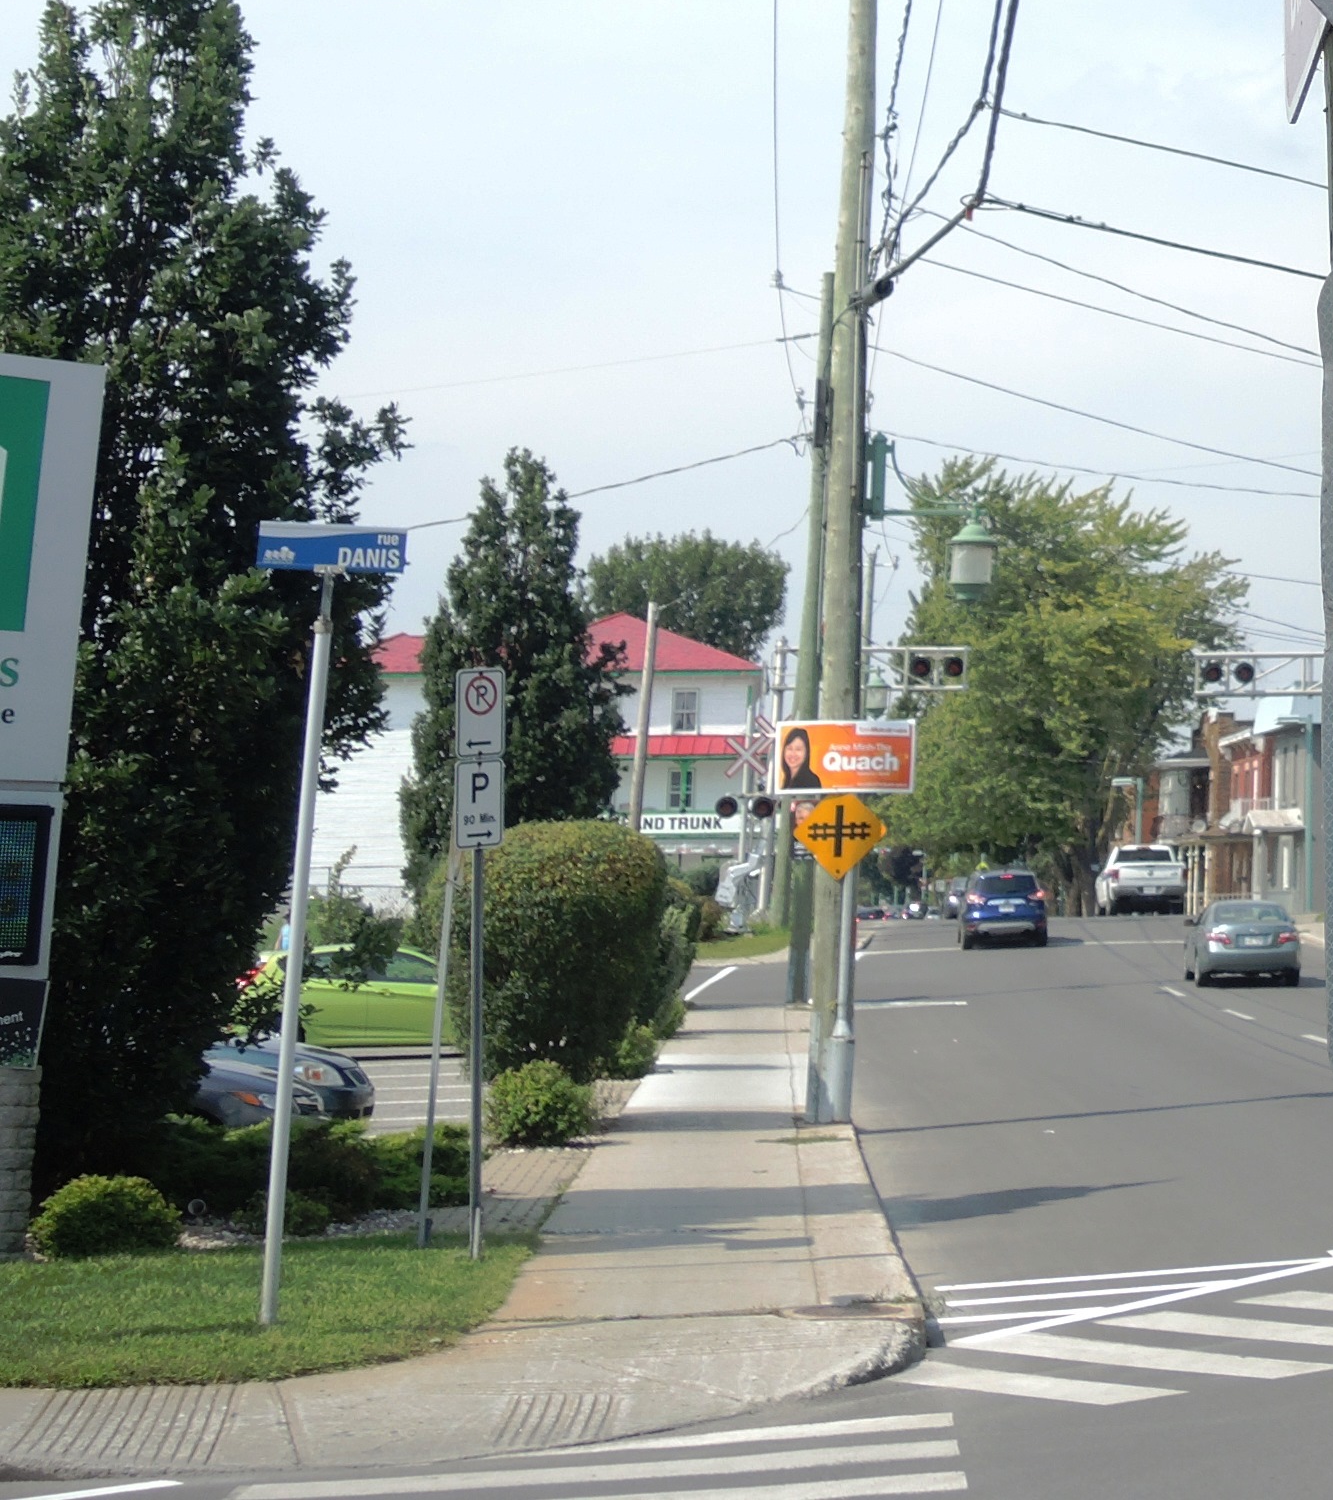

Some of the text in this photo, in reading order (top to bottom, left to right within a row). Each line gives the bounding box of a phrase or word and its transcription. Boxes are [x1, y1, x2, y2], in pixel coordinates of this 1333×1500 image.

[377, 533, 399, 546] rue
[337, 546, 400, 569] DANIS
[822, 751, 899, 772] Quach
[472, 772, 489, 803] P
[463, 814, 476, 826] 90
[641, 816, 723, 830] ND TRUNK
